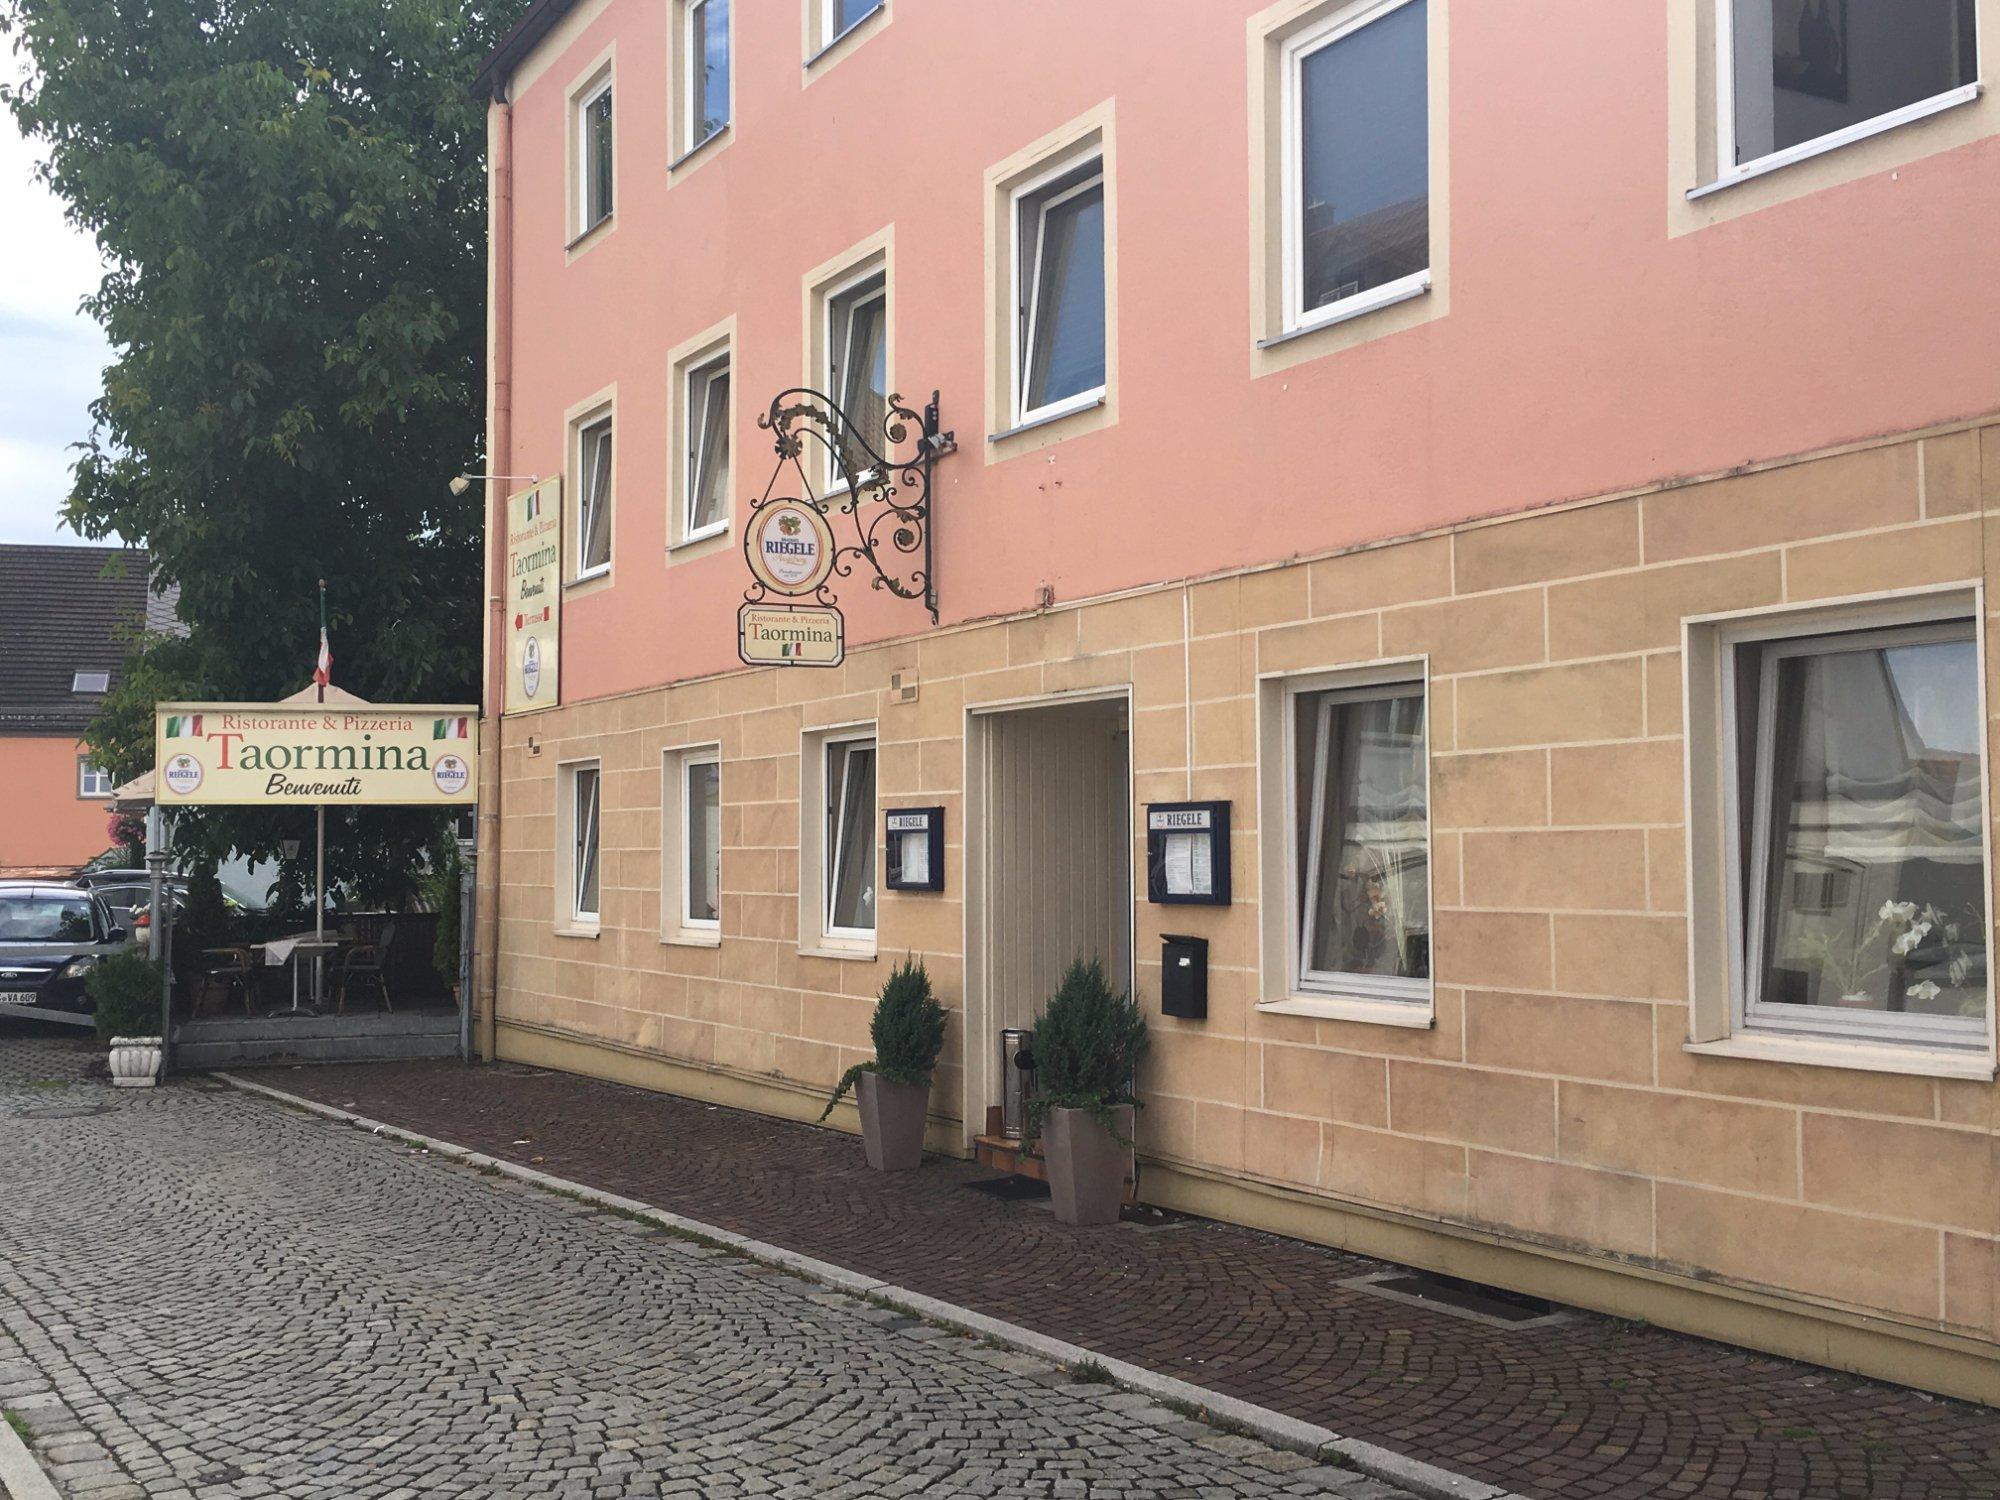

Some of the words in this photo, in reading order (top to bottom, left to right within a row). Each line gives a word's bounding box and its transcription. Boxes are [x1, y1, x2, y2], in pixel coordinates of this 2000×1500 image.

[766, 541, 815, 556] RIEGELE
[510, 541, 557, 578] Taormina
[751, 613, 791, 623] Ristorante
[800, 616, 829, 625] Pizzeria
[749, 623, 832, 642] Taormina
[222, 714, 317, 731] Ristorante
[322, 715, 337, 730] &
[344, 716, 413, 732] Pizzeria
[207, 732, 430, 771] Taormina
[168, 771, 198, 779] RIEGELE
[436, 771, 465, 779] RIEGELE
[265, 773, 362, 796] Benvenuti
[899, 816, 923, 827] RIEGELE
[1167, 812, 1202, 826] RIEGELE
